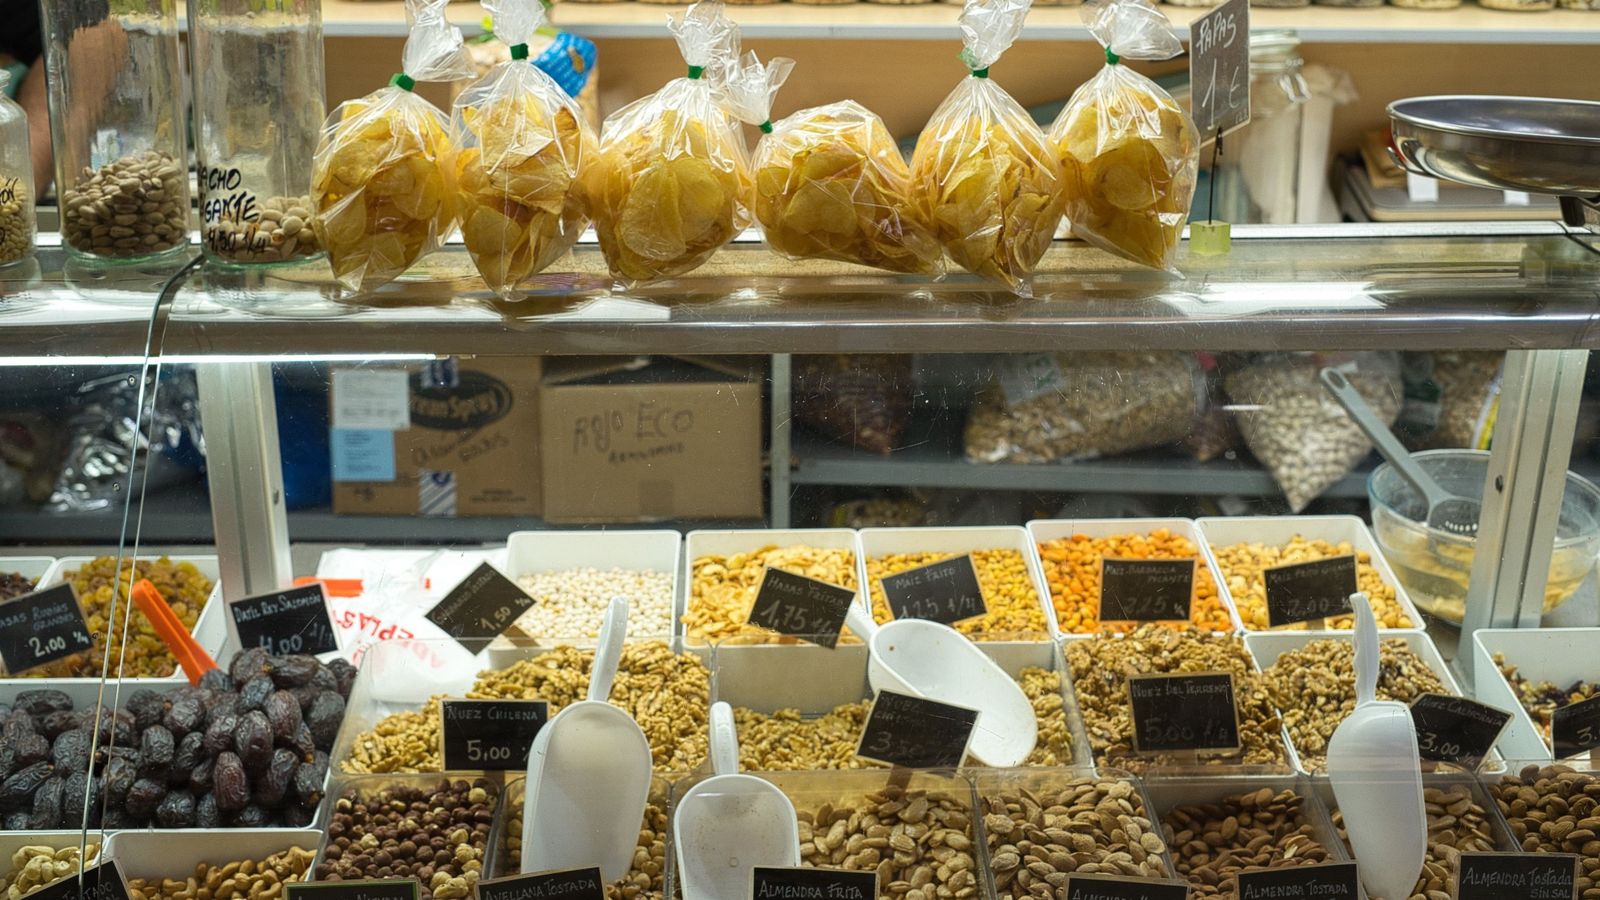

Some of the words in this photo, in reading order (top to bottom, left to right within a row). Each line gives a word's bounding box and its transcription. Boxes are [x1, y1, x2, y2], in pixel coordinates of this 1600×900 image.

[1195, 12, 1237, 55] PAPAS
[1201, 58, 1218, 132] 1
[0, 178, 19, 204] ÓN
[242, 227, 267, 255] 1/4
[0, 613, 28, 628] ASAS
[480, 606, 512, 631] 1,50
[29, 637, 67, 658] 2,00
[488, 706, 539, 721] CHILENA
[466, 739, 512, 762] 5,00
[1419, 732, 1461, 756] 3,00
[1462, 867, 1527, 887] ALMENDRA
[62, 881, 113, 900] TOTADO
[758, 880, 823, 899] ALMENDRA
[827, 882, 864, 900] FRITA
[1243, 883, 1304, 899] ALMENDRA
[1552, 887, 1571, 899] SAL
